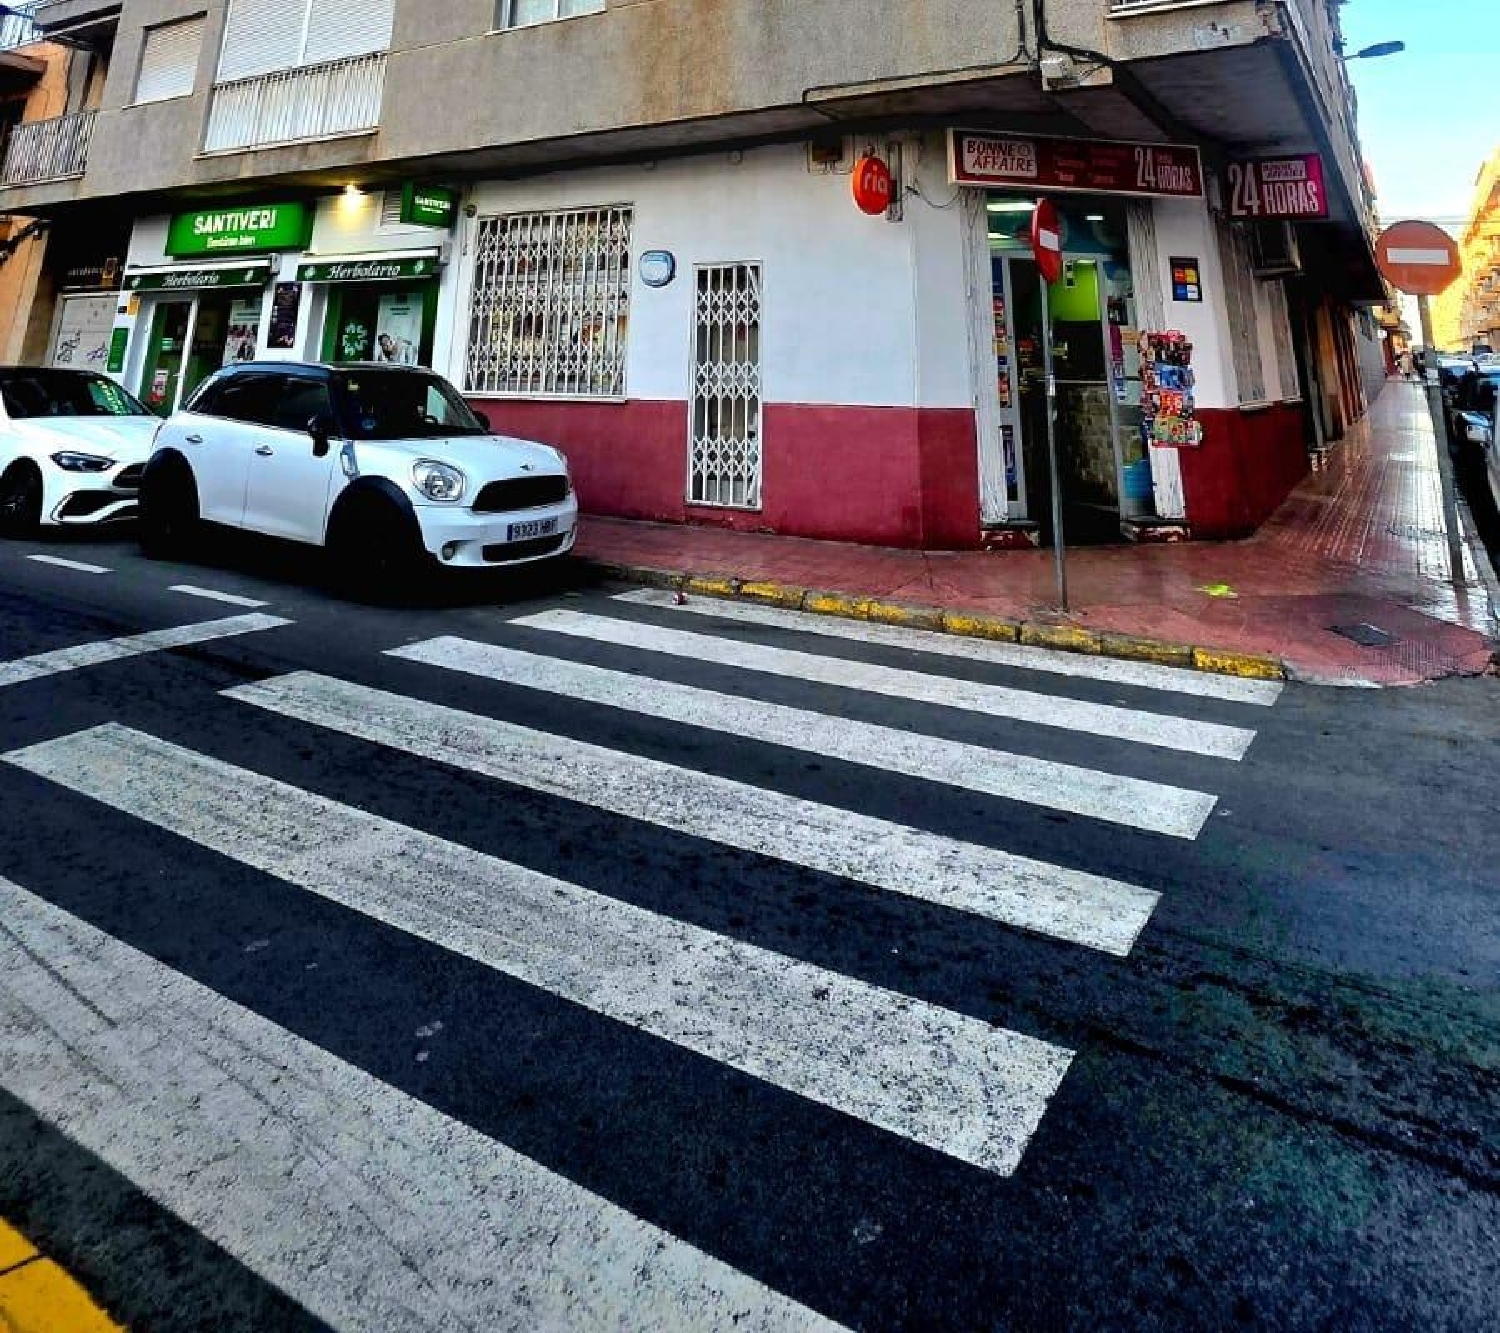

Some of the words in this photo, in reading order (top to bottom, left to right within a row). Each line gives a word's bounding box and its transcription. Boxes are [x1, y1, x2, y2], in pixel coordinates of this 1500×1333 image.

[966, 140, 1015, 157] BONNE
[863, 165, 888, 195] ria
[1135, 146, 1156, 187] 24
[1157, 165, 1193, 191] HORAS
[1228, 162, 1261, 216] 24
[1262, 180, 1319, 214] HORAS
[193, 209, 278, 236] SANTIVERI
[326, 261, 401, 280] Herbolario
